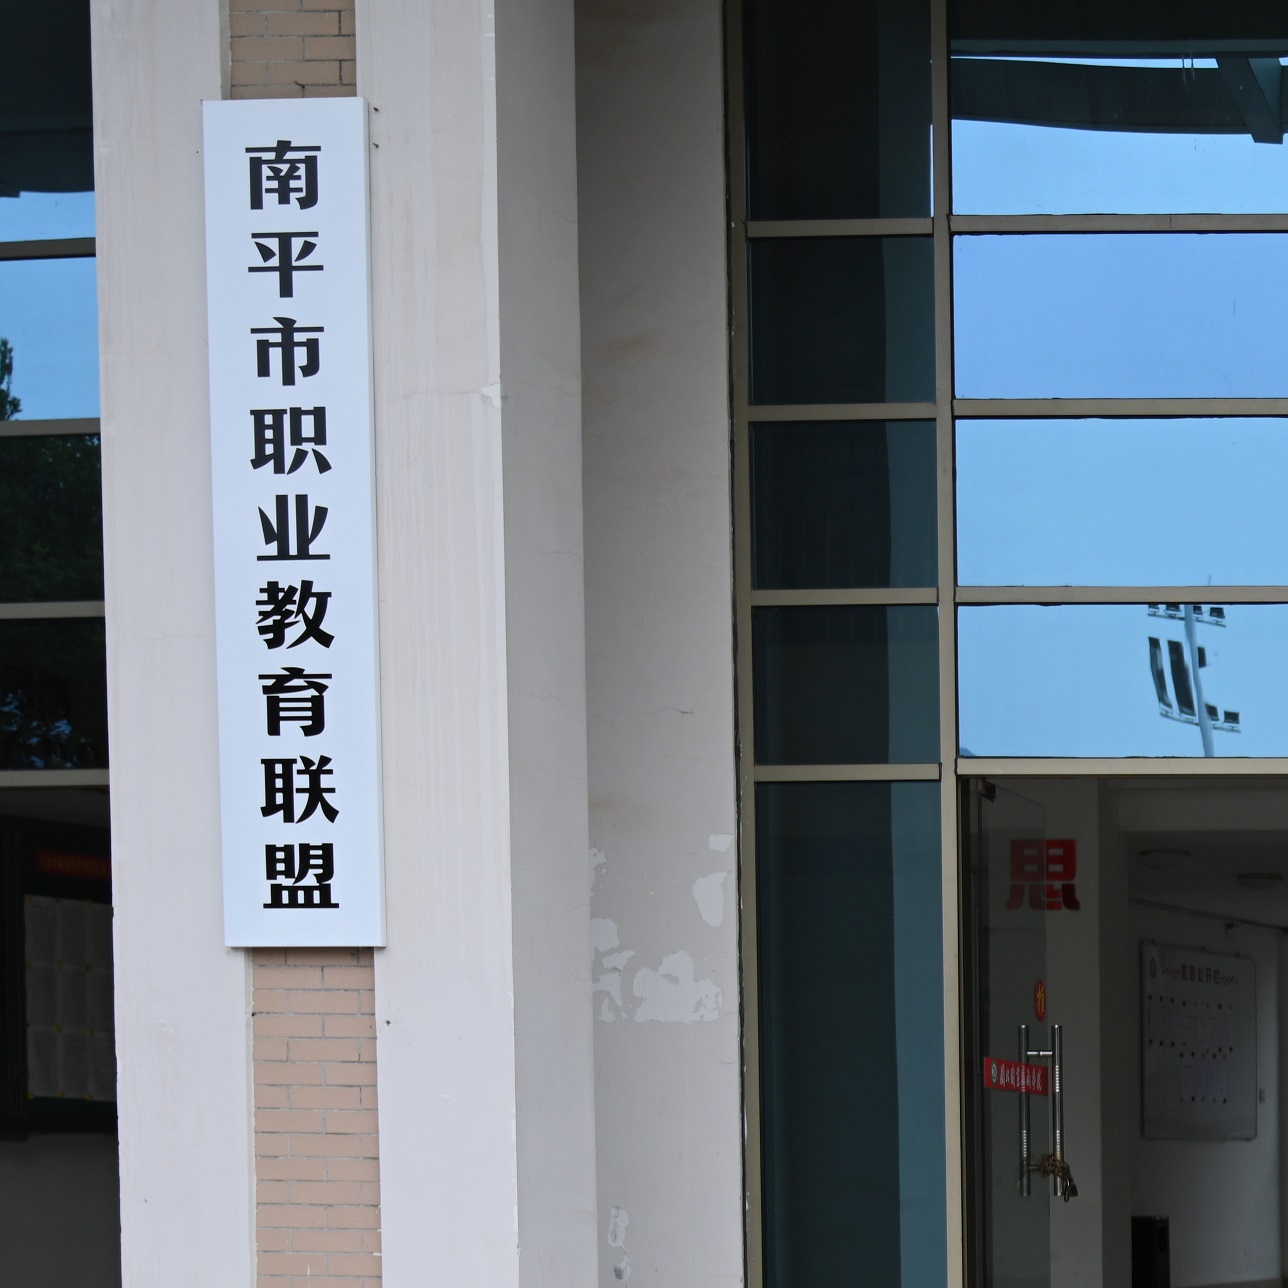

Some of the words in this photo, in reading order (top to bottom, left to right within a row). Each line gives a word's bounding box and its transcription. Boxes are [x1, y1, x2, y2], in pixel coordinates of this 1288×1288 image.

[245, 140, 340, 909] 南平市职业教育联盟
